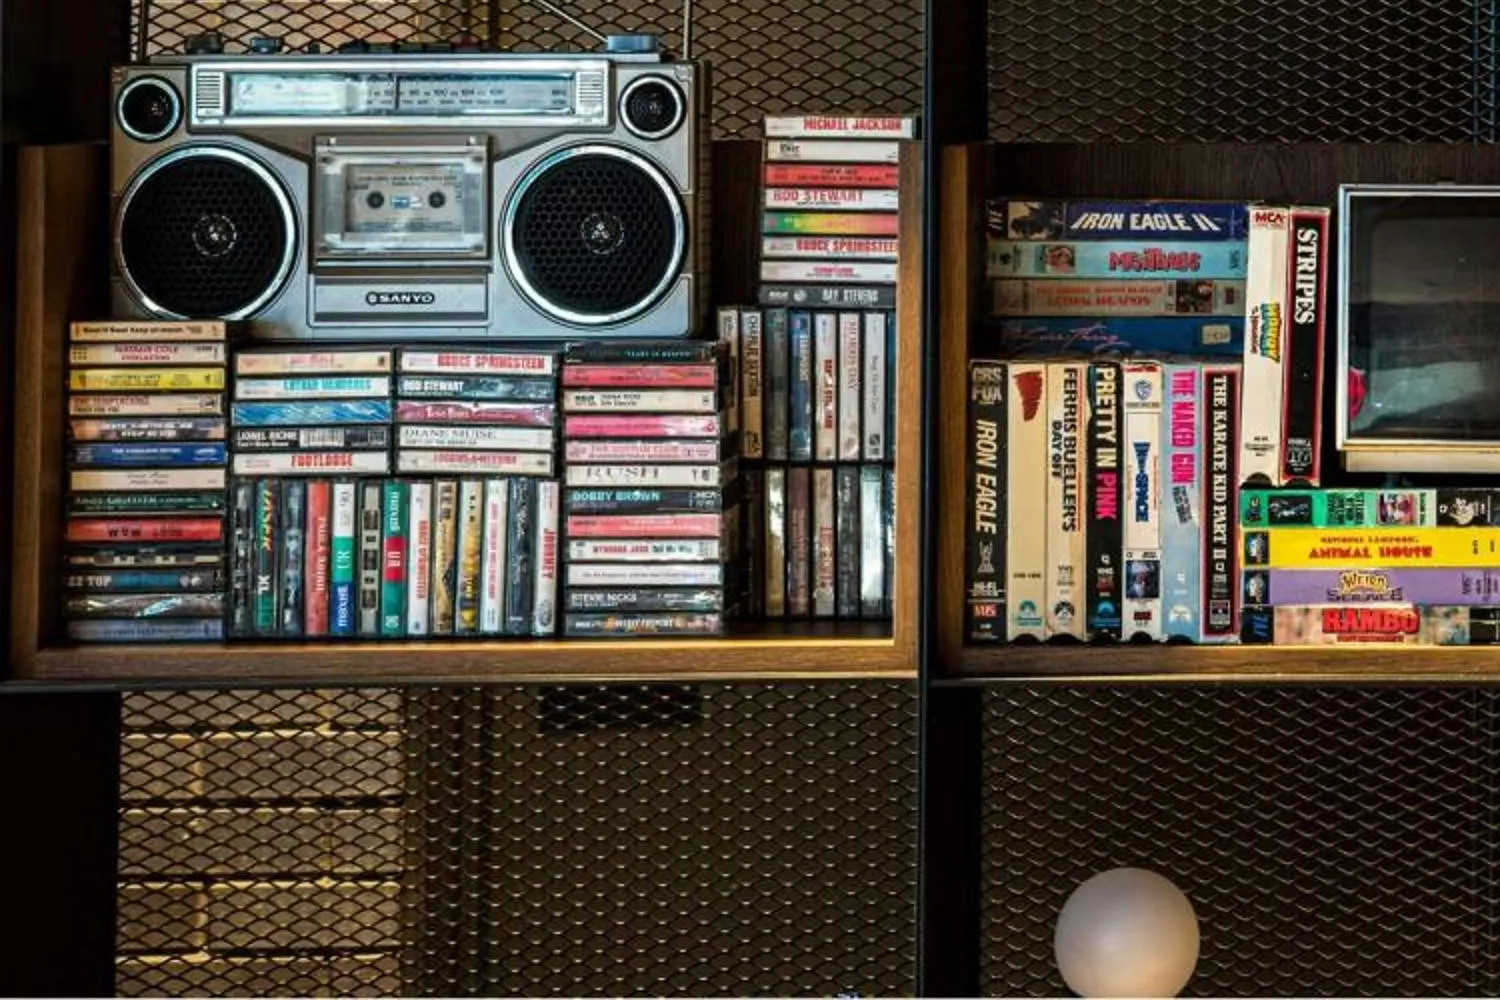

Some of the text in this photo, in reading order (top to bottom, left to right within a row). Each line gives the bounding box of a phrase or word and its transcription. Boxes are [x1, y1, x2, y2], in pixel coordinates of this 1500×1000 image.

[803, 191, 864, 201] STEWART
[1070, 213, 1221, 231] IRON EAGLE II
[1256, 212, 1286, 223] MCA
[377, 292, 434, 304] SANYO
[1294, 228, 1319, 324] STRIPES
[1051, 420, 1062, 479] DAY OFF
[1062, 368, 1078, 532] FERRIS BUELLER'S
[1095, 368, 1116, 519] PRETTY IN PINK
[1171, 371, 1195, 484] THE NAKED GUN
[976, 420, 996, 534] IRON EAGLE
[1213, 375, 1227, 560] THE KARATE KID PART II
[542, 528, 556, 580] JOURNEY
[1309, 546, 1432, 559] ANIMAL HOUSE
[87, 576, 111, 586] TOP
[1322, 608, 1419, 633] RAMBO
